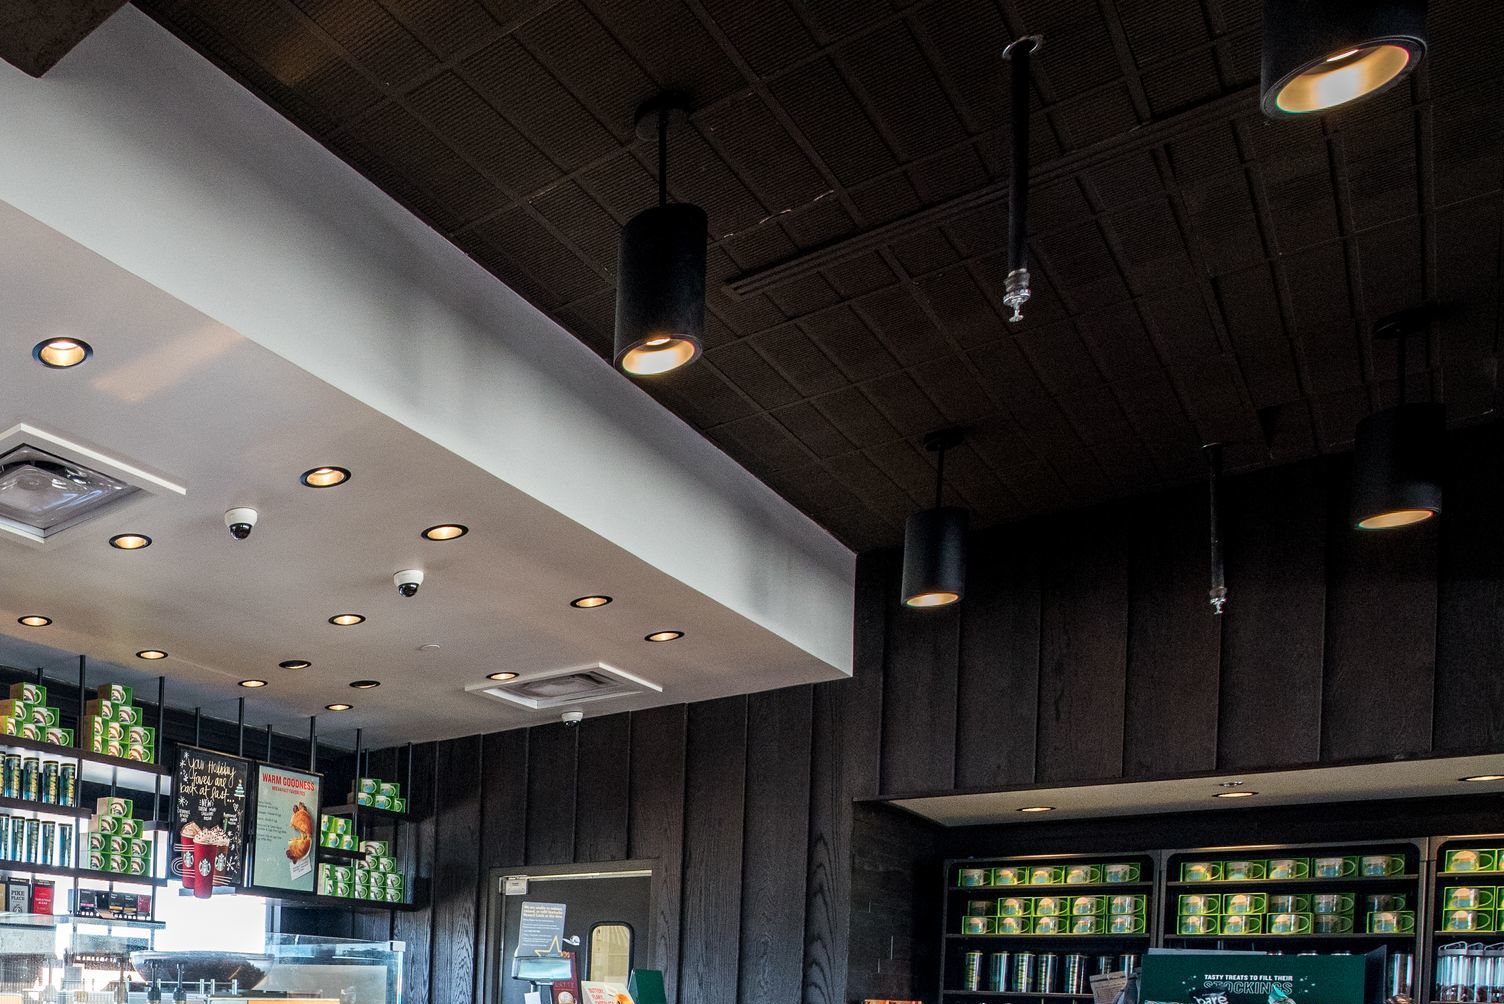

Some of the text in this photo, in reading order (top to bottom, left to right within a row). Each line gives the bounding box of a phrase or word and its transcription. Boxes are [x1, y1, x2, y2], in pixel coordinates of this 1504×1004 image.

[180, 783, 198, 796] back
[263, 773, 314, 791] WARM GOODNESS
